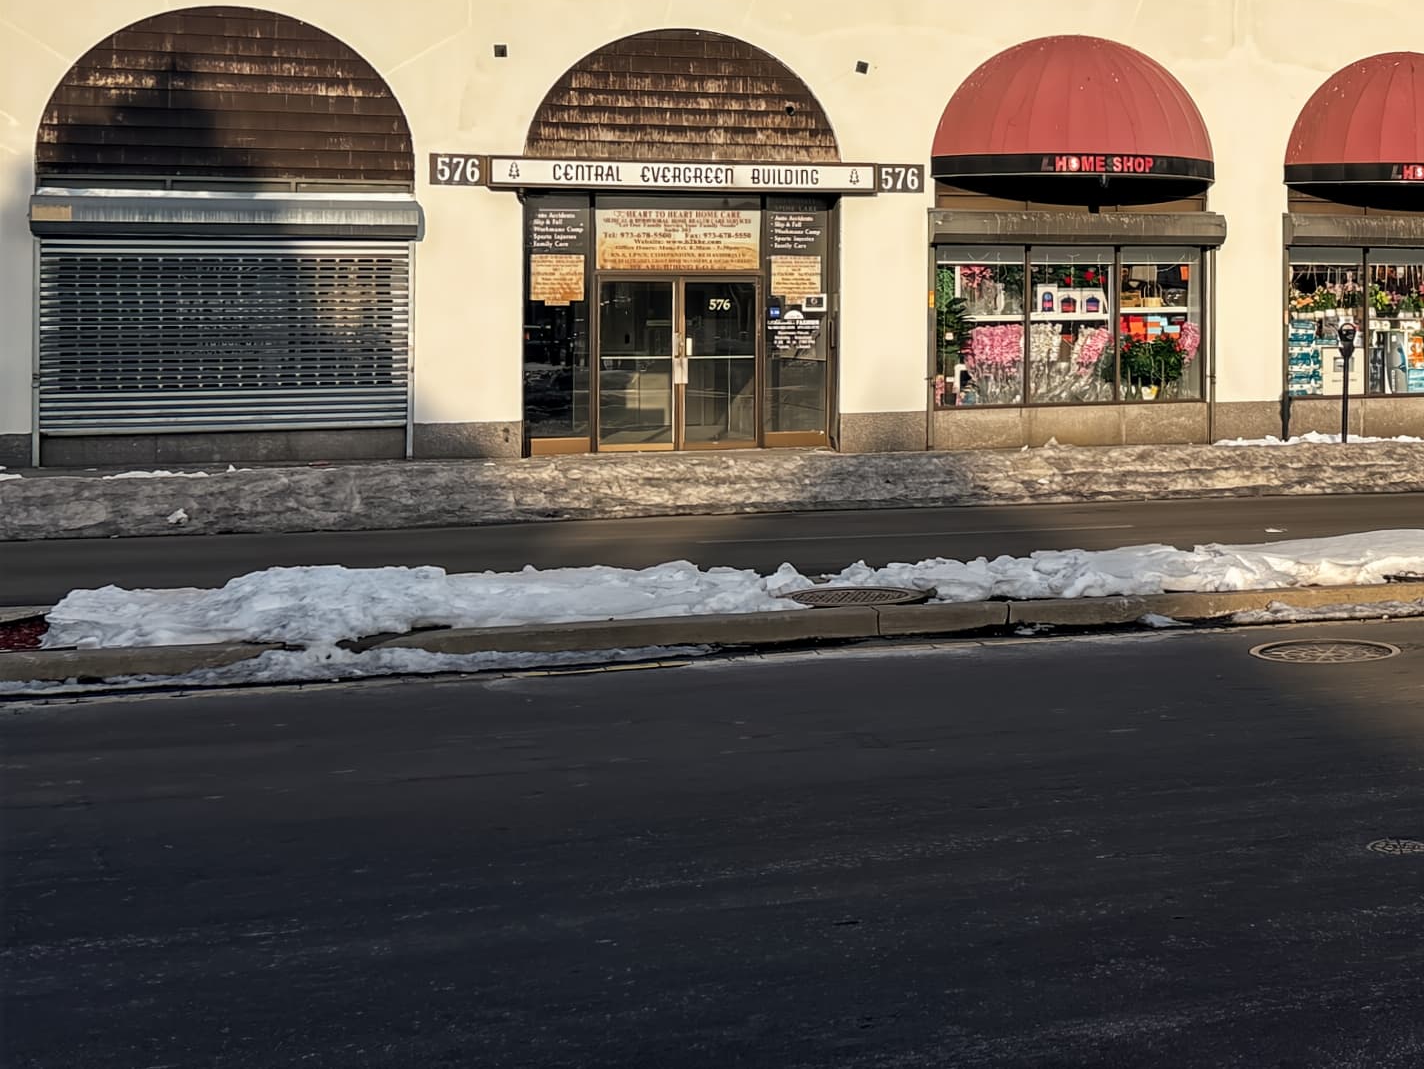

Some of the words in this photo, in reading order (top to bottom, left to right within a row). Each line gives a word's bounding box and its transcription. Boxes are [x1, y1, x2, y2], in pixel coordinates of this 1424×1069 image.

[436, 156, 480, 182] 576
[552, 163, 623, 182] CENTRAL
[640, 165, 735, 185] EVERGREEN
[750, 168, 820, 186] BUILDING
[1055, 155, 1106, 172] HOME
[1113, 156, 1153, 173] SHOP
[881, 167, 919, 190] 576
[709, 298, 731, 311] 576
